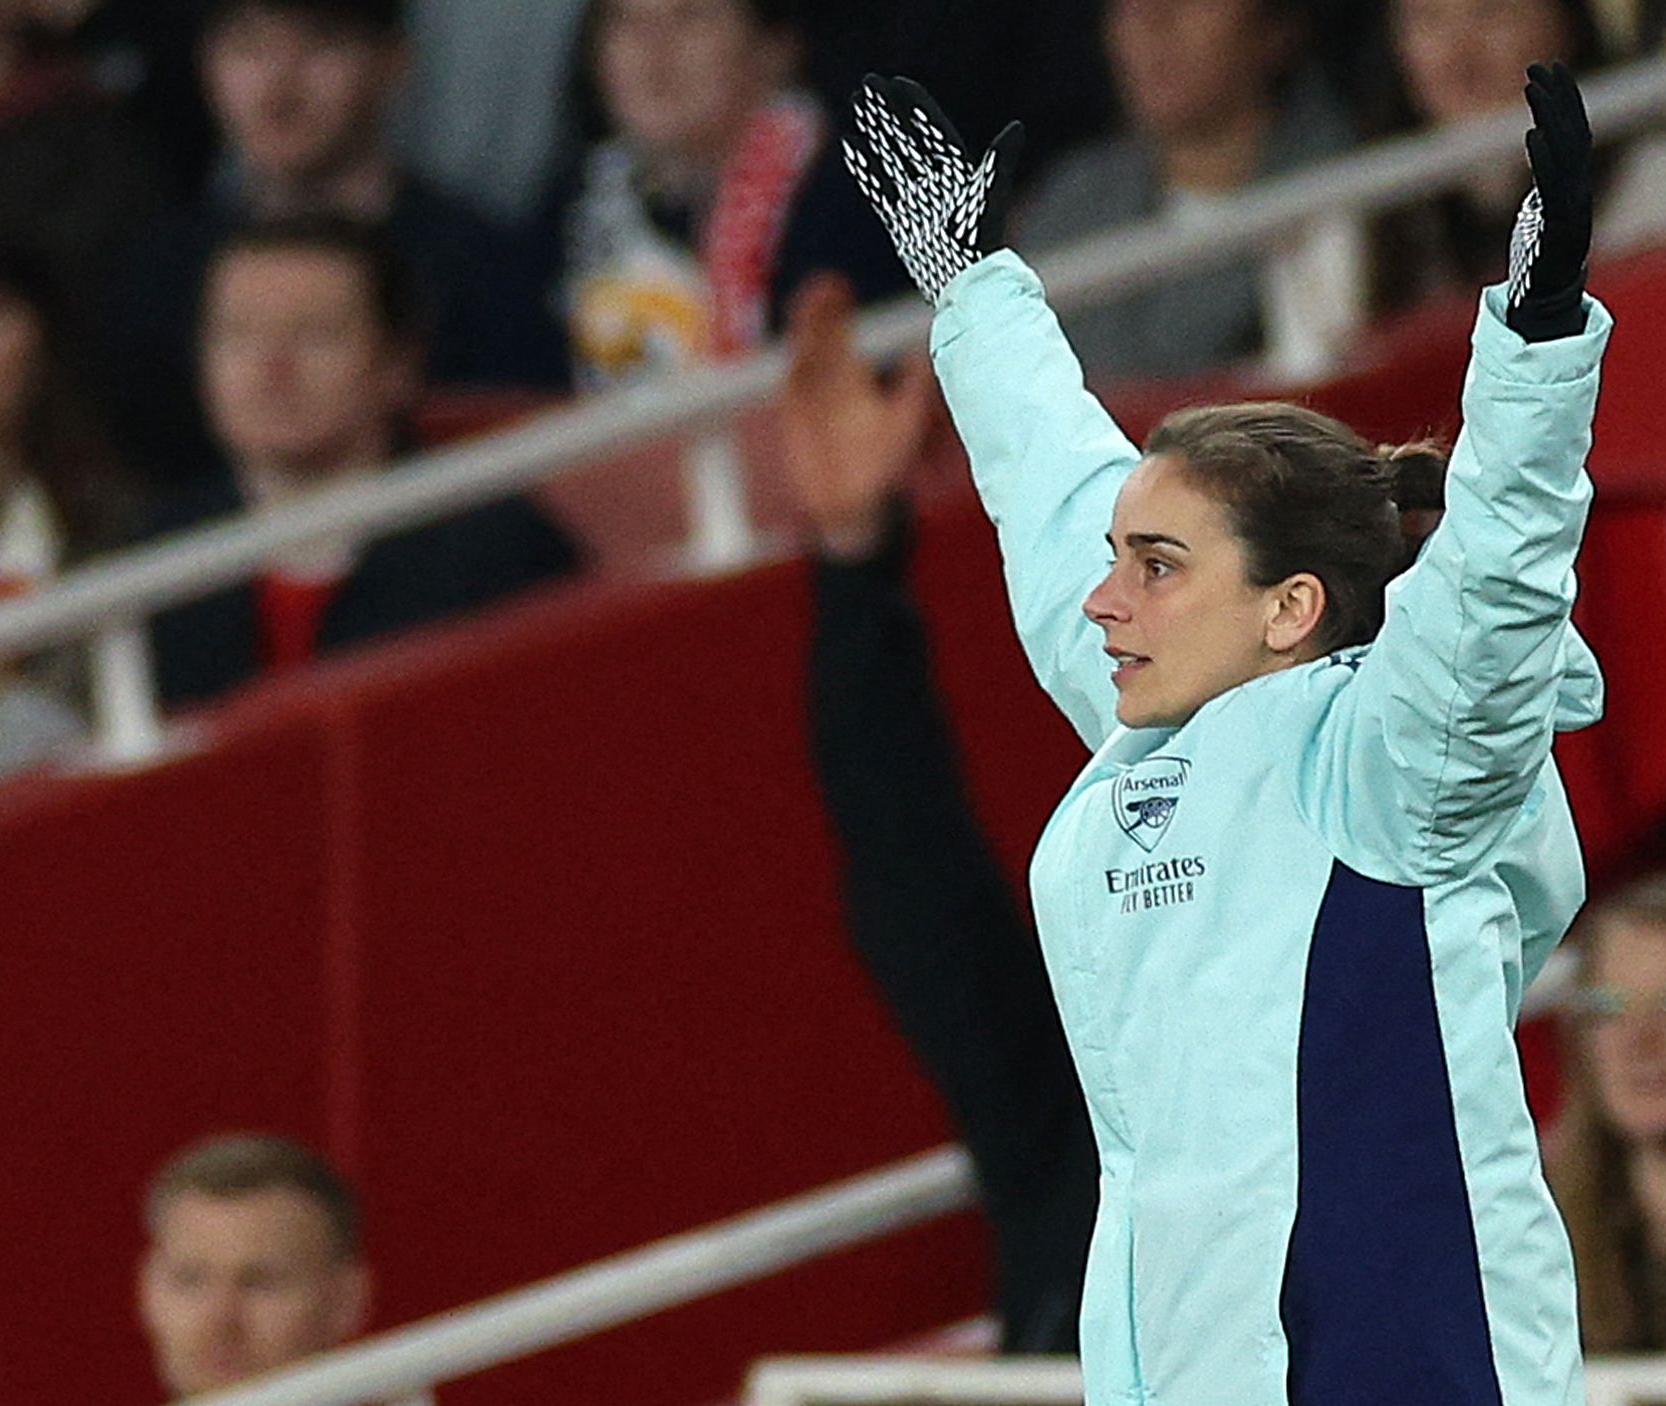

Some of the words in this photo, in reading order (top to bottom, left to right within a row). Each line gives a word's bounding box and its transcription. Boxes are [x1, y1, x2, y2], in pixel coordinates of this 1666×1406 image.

[1123, 772, 1184, 792] Arsenal
[1105, 855, 1206, 895] Emirates
[1142, 881, 1195, 909] BETTER
